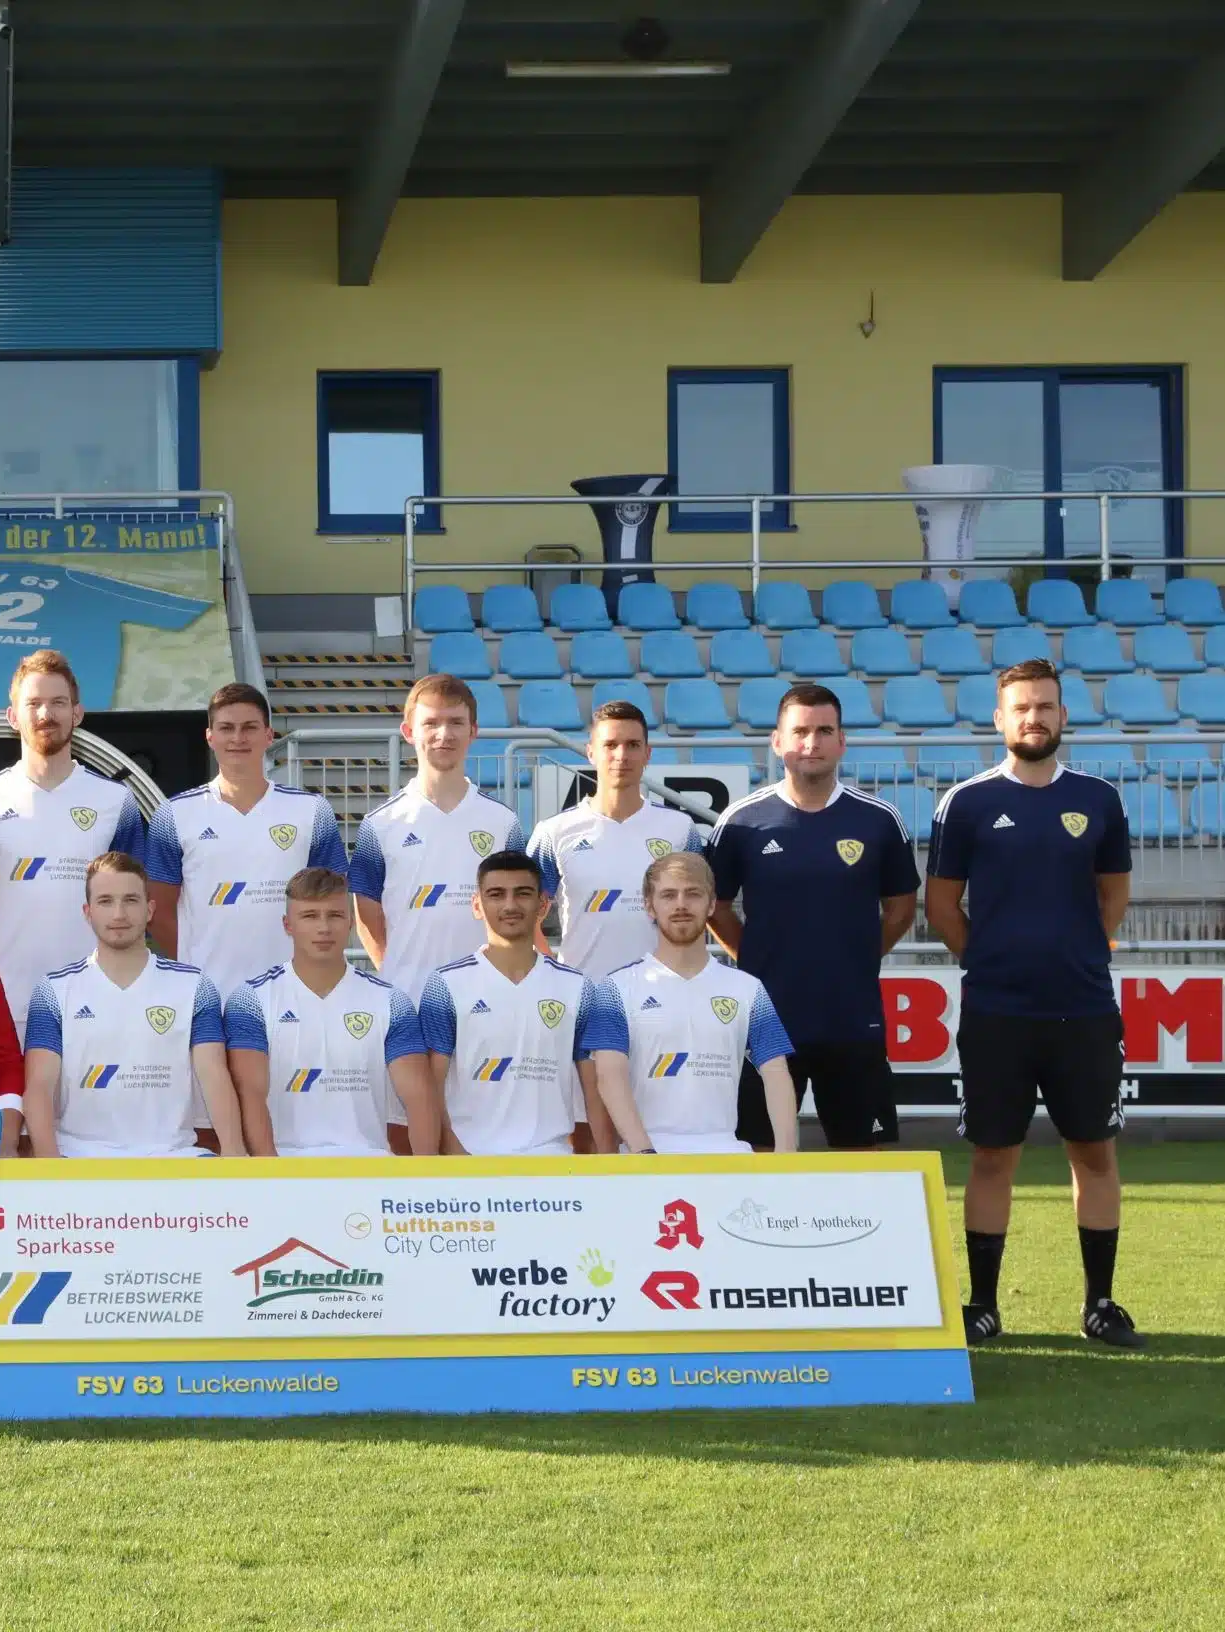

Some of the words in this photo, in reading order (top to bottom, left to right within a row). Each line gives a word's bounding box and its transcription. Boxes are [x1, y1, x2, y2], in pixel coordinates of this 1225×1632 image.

[5, 523, 50, 550] der
[65, 523, 107, 549] 12.
[119, 523, 207, 549] Mann!
[20, 574, 60, 590] 63
[381, 1198, 481, 1214] Reisebüro
[487, 1198, 583, 1213] Intertours
[17, 1212, 249, 1233] Mittelbrandenburgische
[382, 1217, 496, 1234] Lufthansa
[766, 1216, 800, 1231] Engel
[810, 1215, 872, 1231] Apotheken
[17, 1238, 115, 1258] Sparkasse
[384, 1236, 422, 1255] City
[429, 1235, 496, 1253] Center
[104, 1270, 202, 1285] STÄDTISCHE
[262, 1268, 383, 1288] Scheddin
[472, 1260, 568, 1287] werbe
[66, 1291, 203, 1305] BETRIEBSWERKE
[319, 1295, 344, 1303] GmbH
[371, 1294, 384, 1302] KG
[710, 1279, 908, 1309] rosenbauer
[84, 1309, 204, 1324] LUCKENWALDE
[247, 1310, 297, 1321] Zimmerei
[300, 1310, 309, 1320] &
[311, 1308, 383, 1320] Dachdeckerei
[498, 1291, 616, 1322] factory
[78, 1376, 124, 1395] FSV
[133, 1377, 164, 1395] 63
[177, 1375, 339, 1394] Luckenwalde
[572, 1368, 619, 1387] FSV
[627, 1368, 657, 1386] 63
[670, 1365, 829, 1384] Luckenwalde
